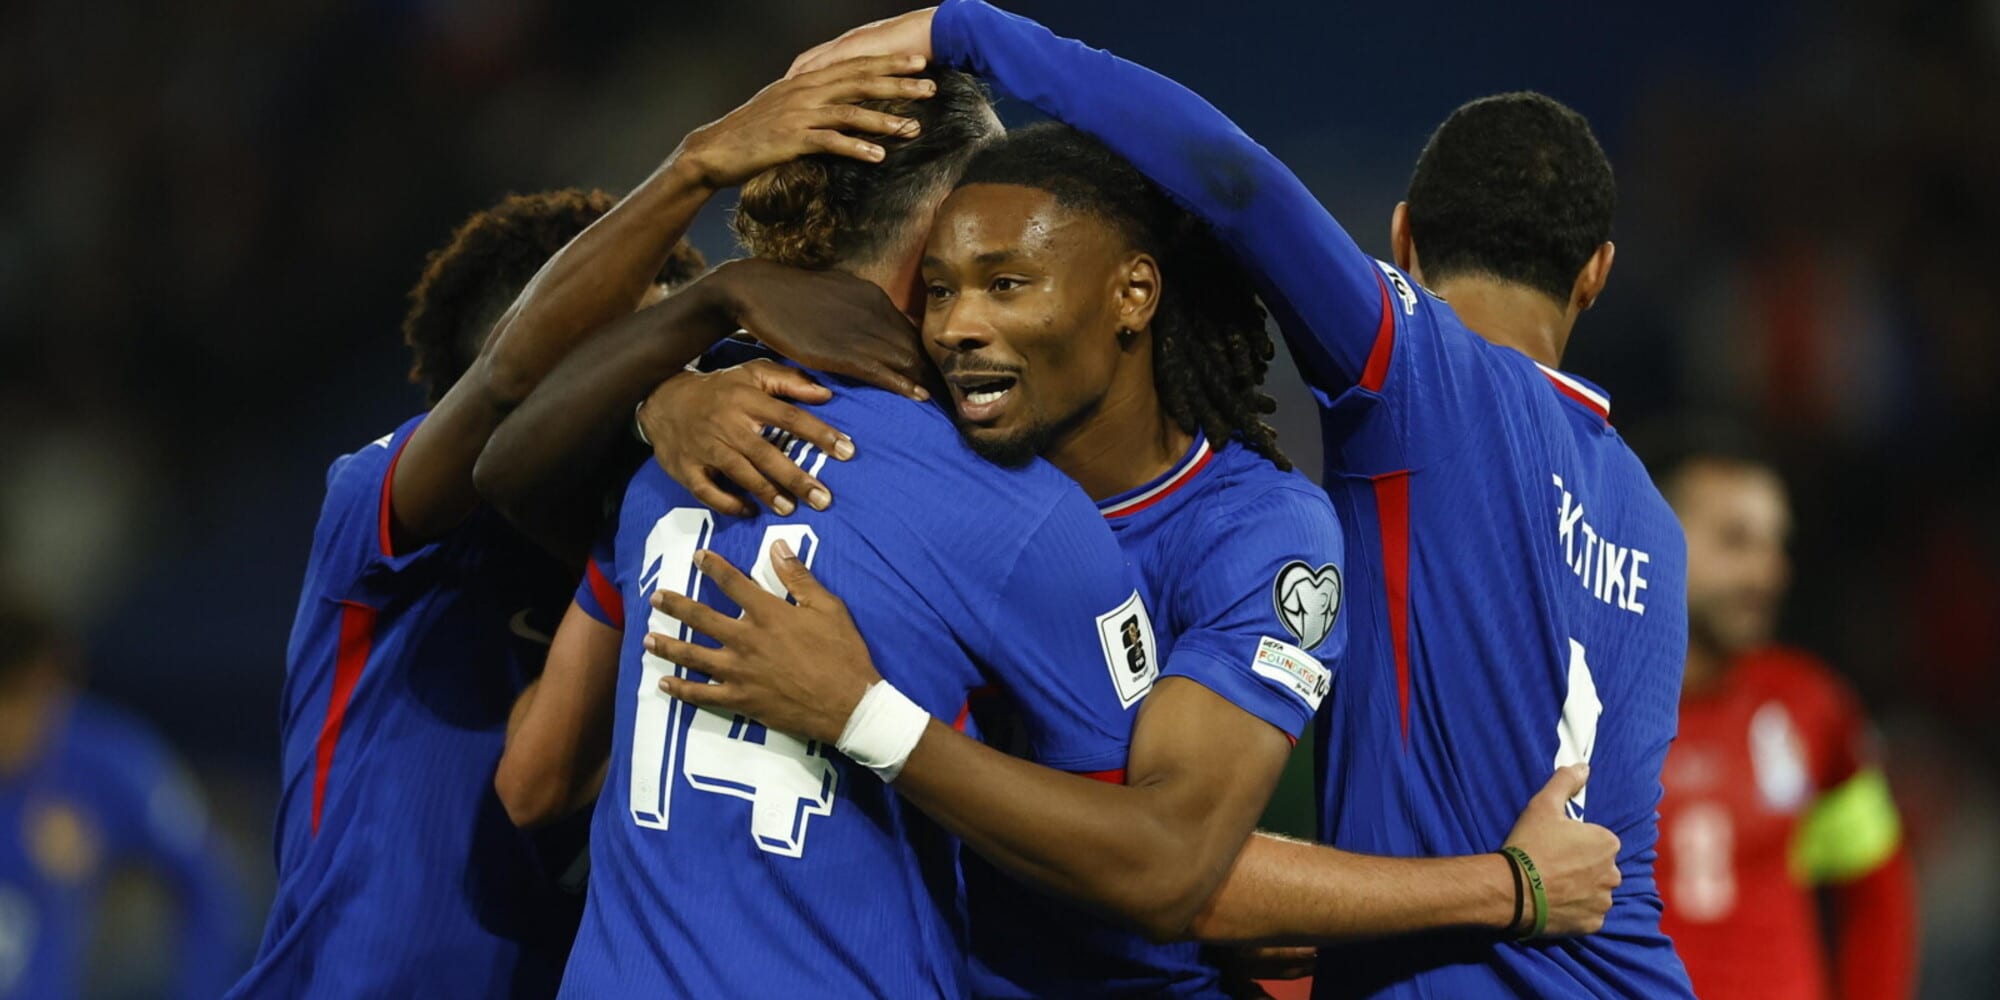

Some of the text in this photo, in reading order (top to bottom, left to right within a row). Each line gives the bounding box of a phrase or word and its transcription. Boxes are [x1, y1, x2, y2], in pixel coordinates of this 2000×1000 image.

[1262, 640, 1284, 651] UEFA
[630, 507, 838, 859] 14
[1258, 650, 1315, 684] FOUNDATIO
